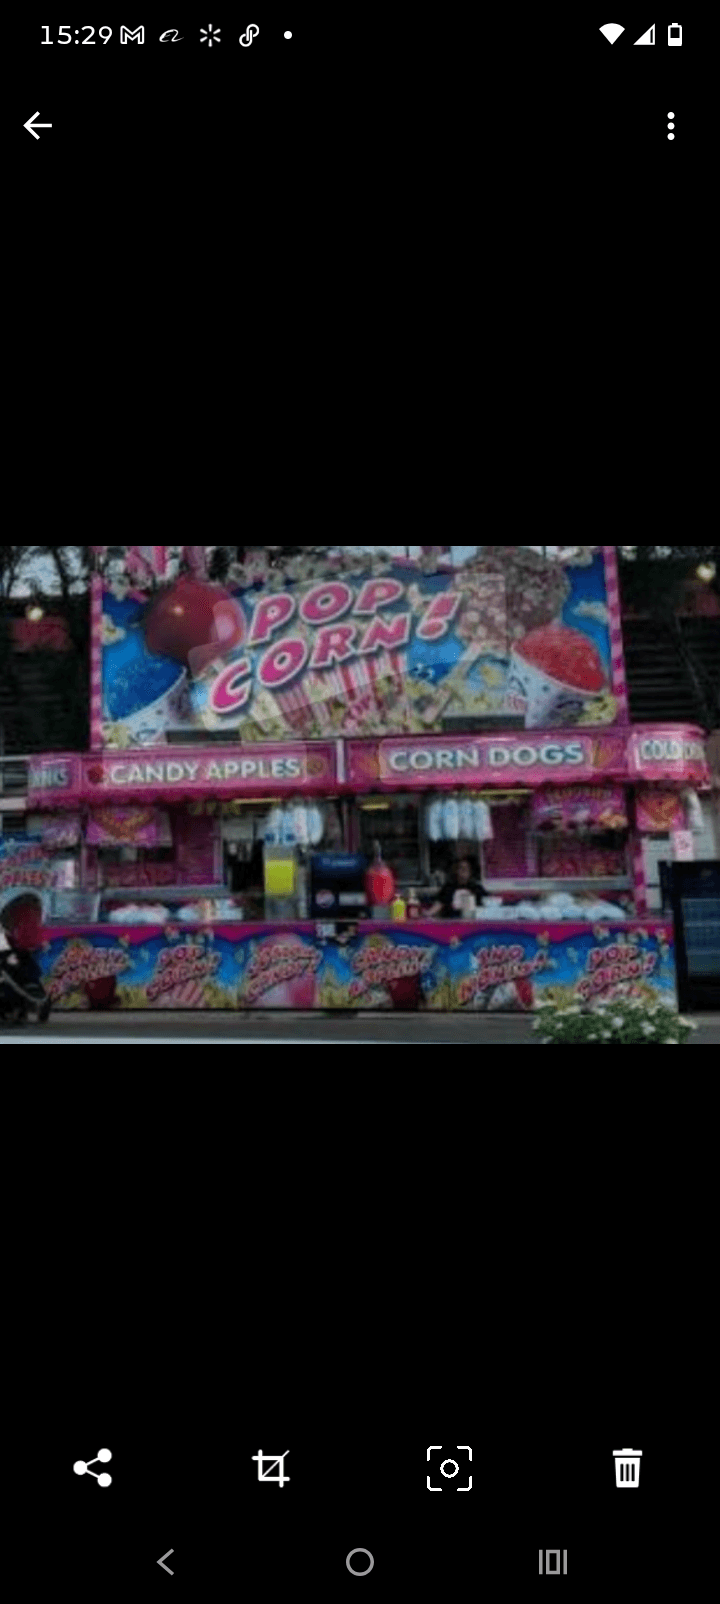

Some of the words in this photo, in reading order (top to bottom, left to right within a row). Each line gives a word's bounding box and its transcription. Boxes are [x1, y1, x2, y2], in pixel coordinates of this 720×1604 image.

[40, 25, 112, 45] 15:29
[248, 578, 404, 647] POP
[208, 592, 462, 713] CORN!
[109, 760, 199, 785] CANDY
[205, 757, 301, 781] APPLES
[388, 747, 480, 772] CORN
[488, 742, 585, 767] DOGS
[585, 943, 639, 974] POP
